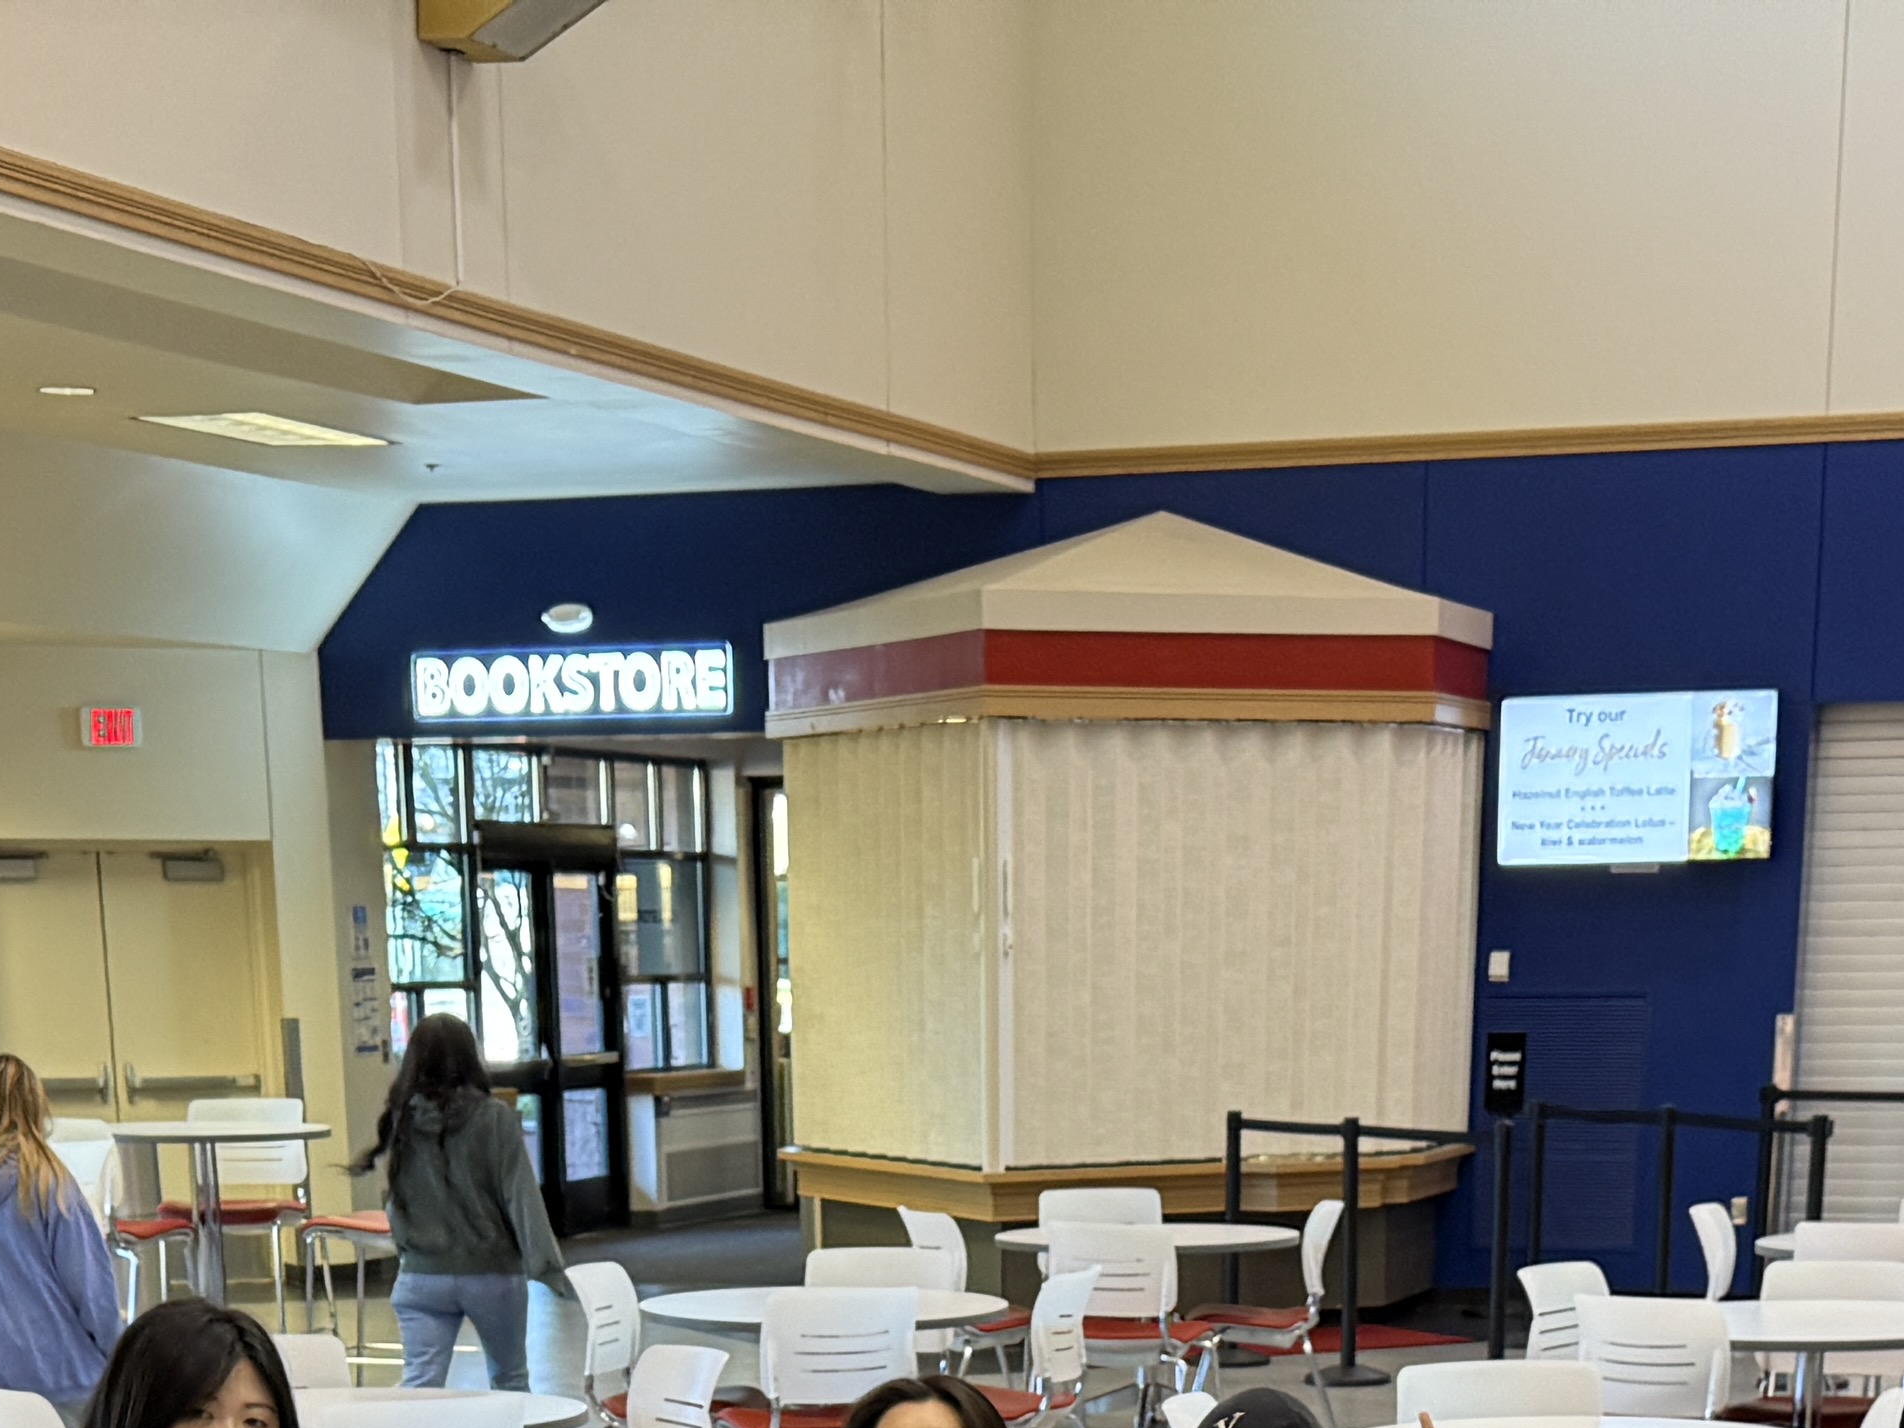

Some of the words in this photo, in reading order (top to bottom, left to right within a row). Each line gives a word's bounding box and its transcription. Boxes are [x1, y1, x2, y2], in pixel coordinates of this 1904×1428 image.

[414, 648, 727, 717] BOOKSTORE
[1566, 708, 1593, 726] Try
[1597, 709, 1626, 722] our
